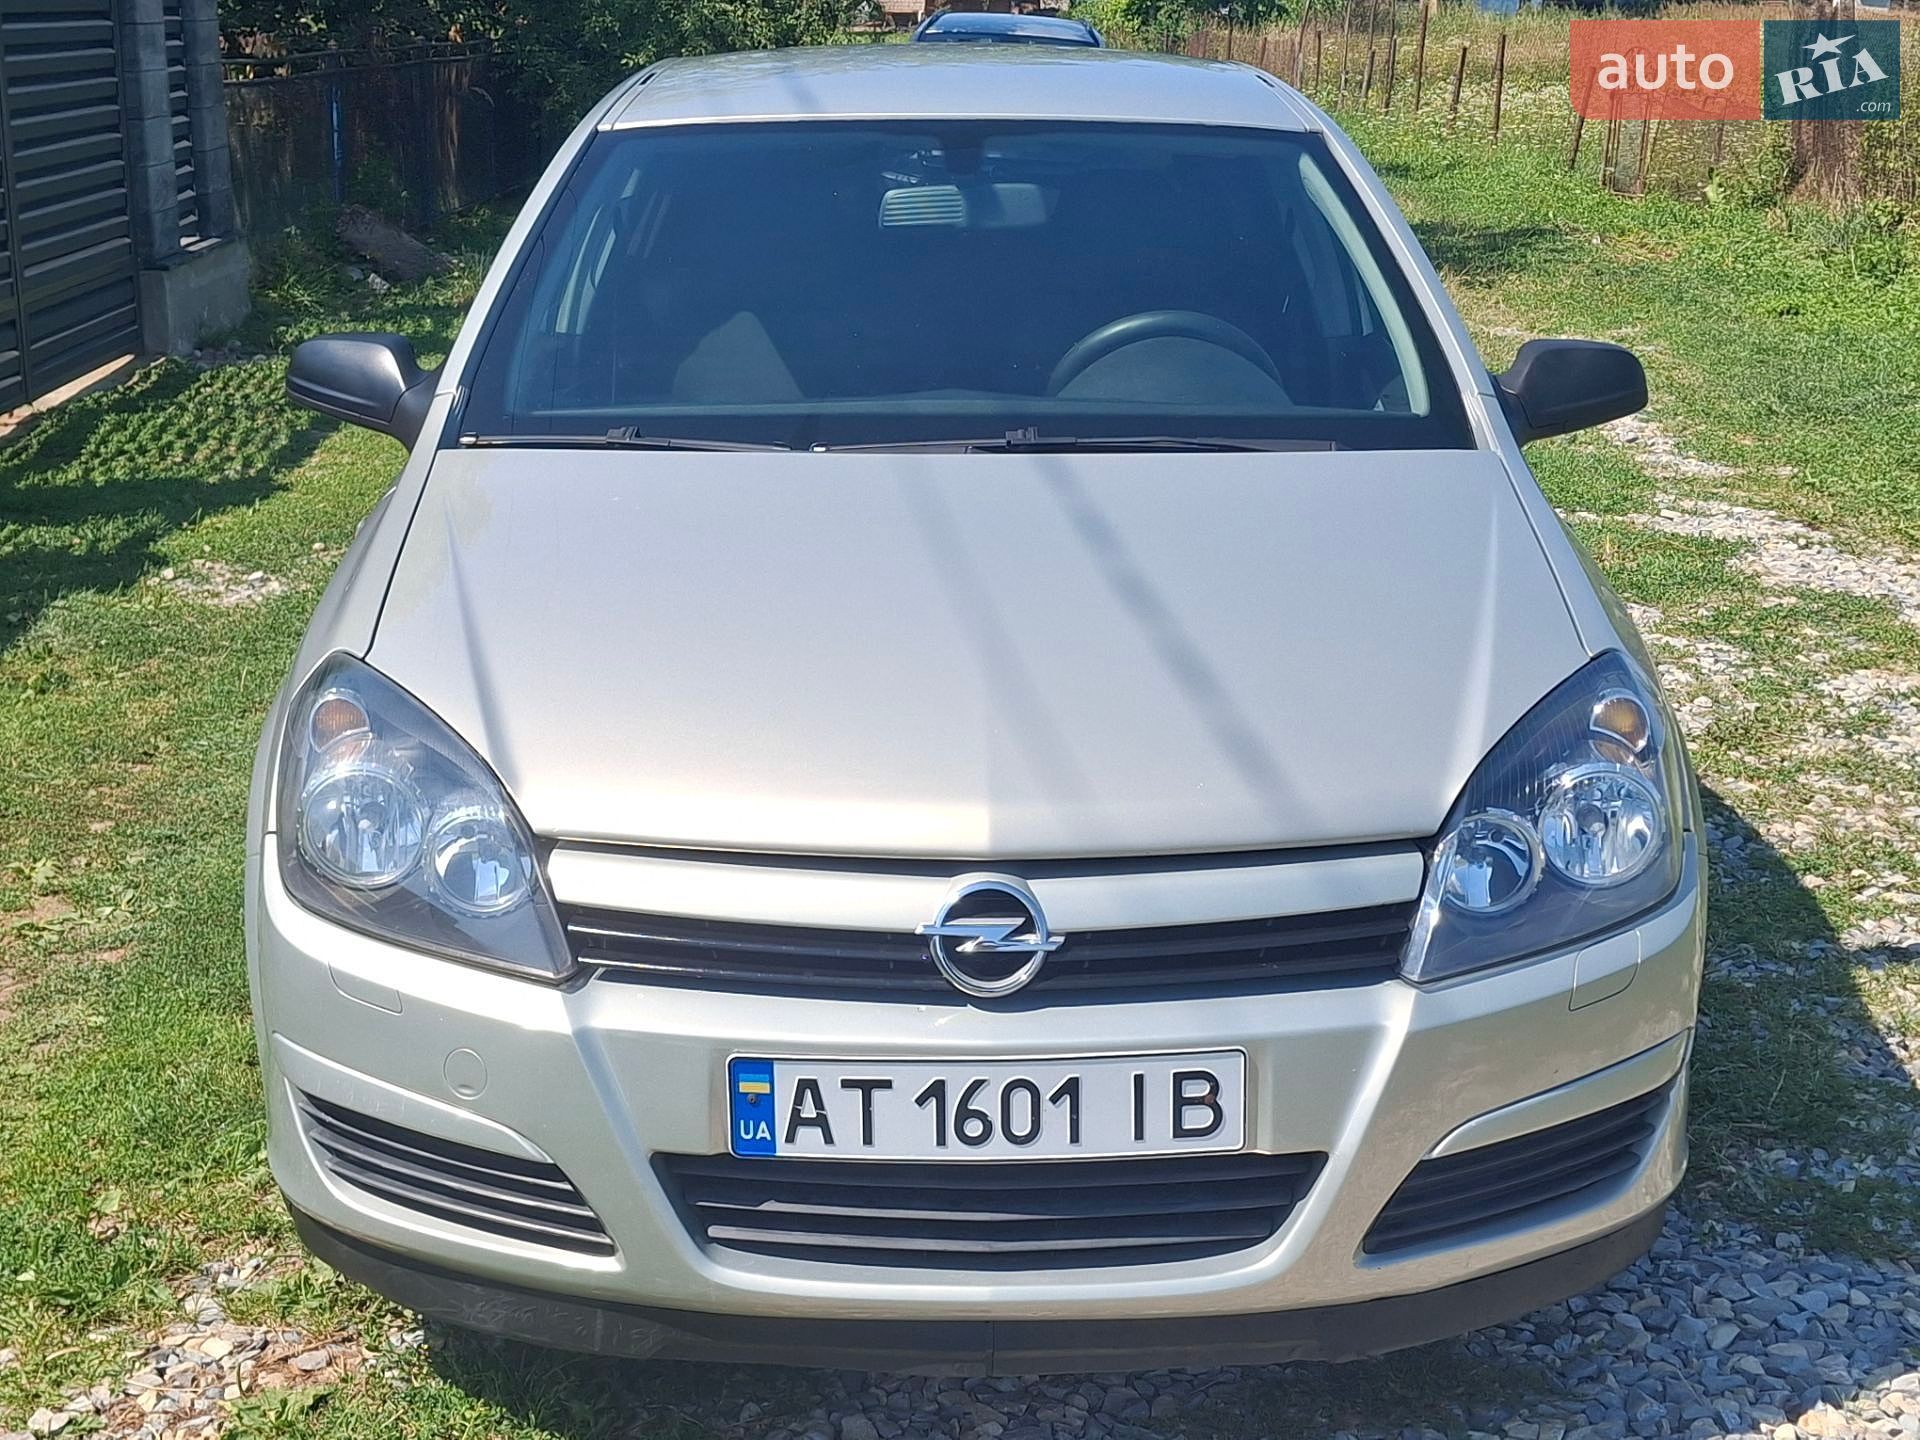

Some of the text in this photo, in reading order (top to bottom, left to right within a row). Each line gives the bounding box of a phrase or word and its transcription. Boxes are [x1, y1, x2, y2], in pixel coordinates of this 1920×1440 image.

[739, 1119, 771, 1141] UA
[784, 1069, 1224, 1147] AT 1601 IB
